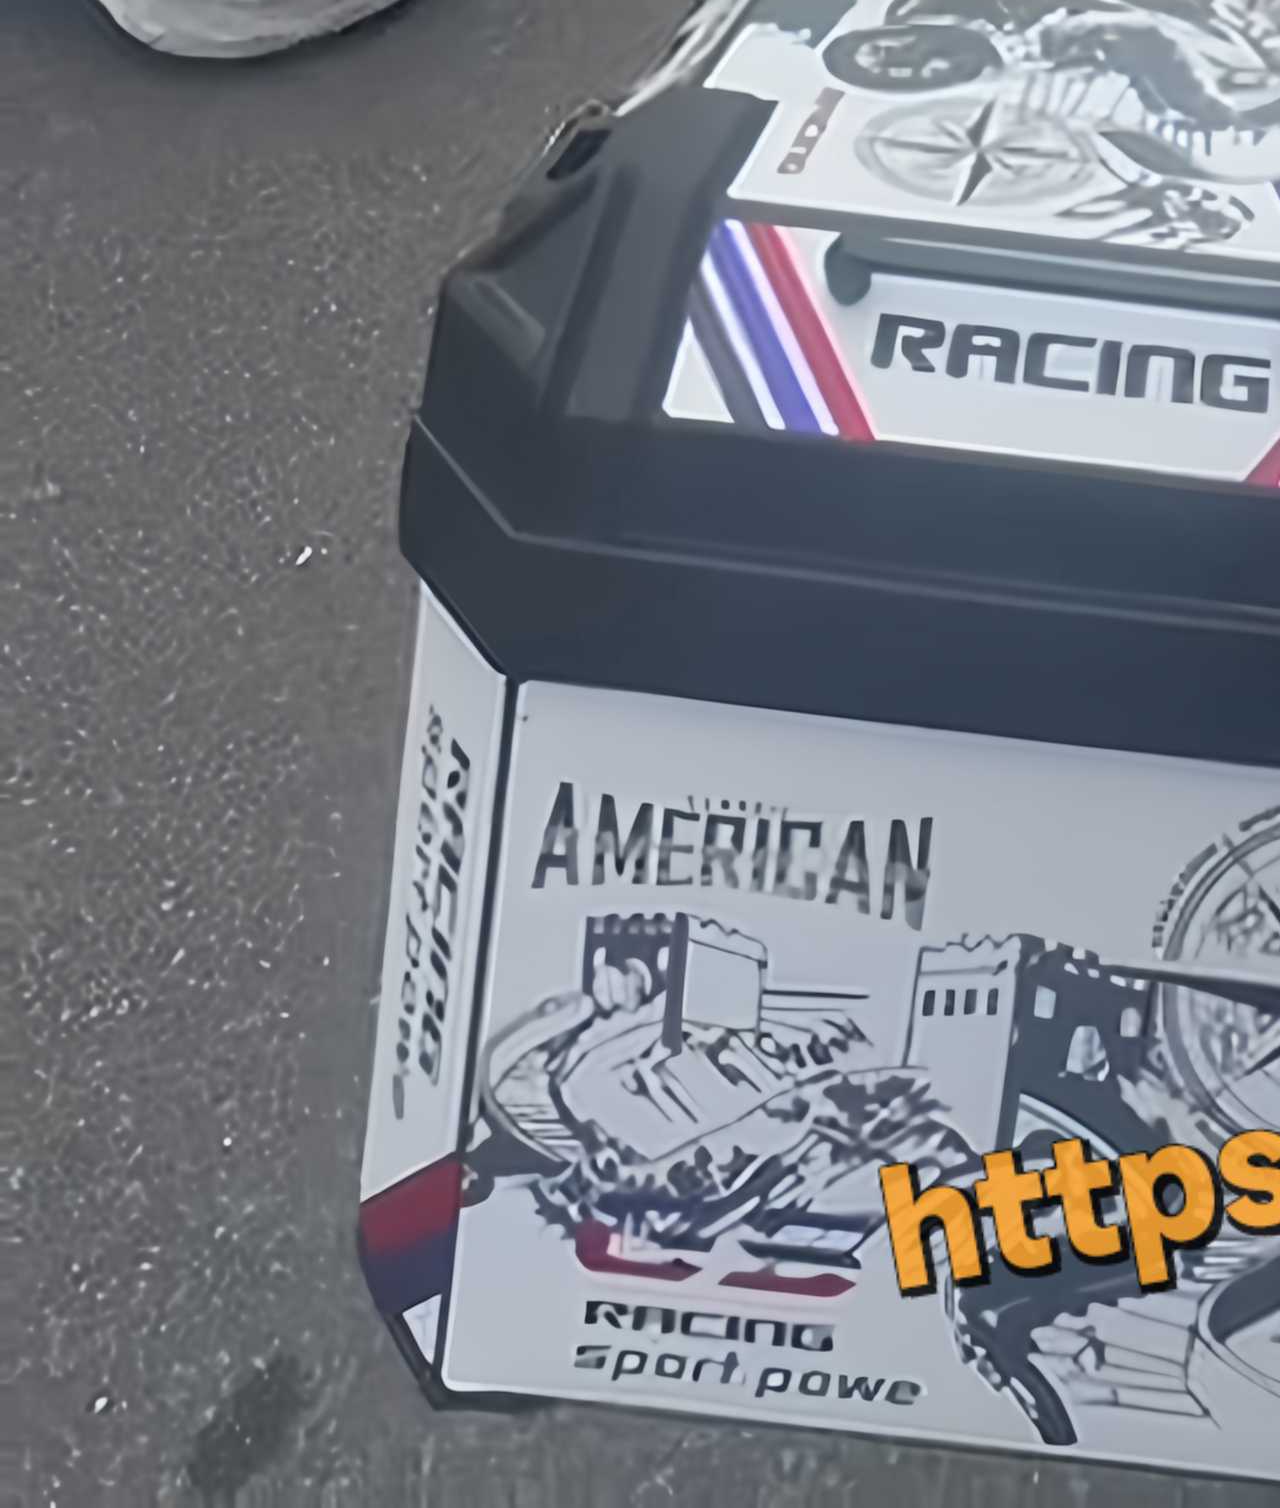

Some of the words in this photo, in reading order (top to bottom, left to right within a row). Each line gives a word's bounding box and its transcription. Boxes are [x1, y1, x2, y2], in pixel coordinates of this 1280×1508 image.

[870, 312, 1271, 414] RACING
[531, 781, 934, 932] AMERICAN
[584, 1300, 835, 1352] RACING
